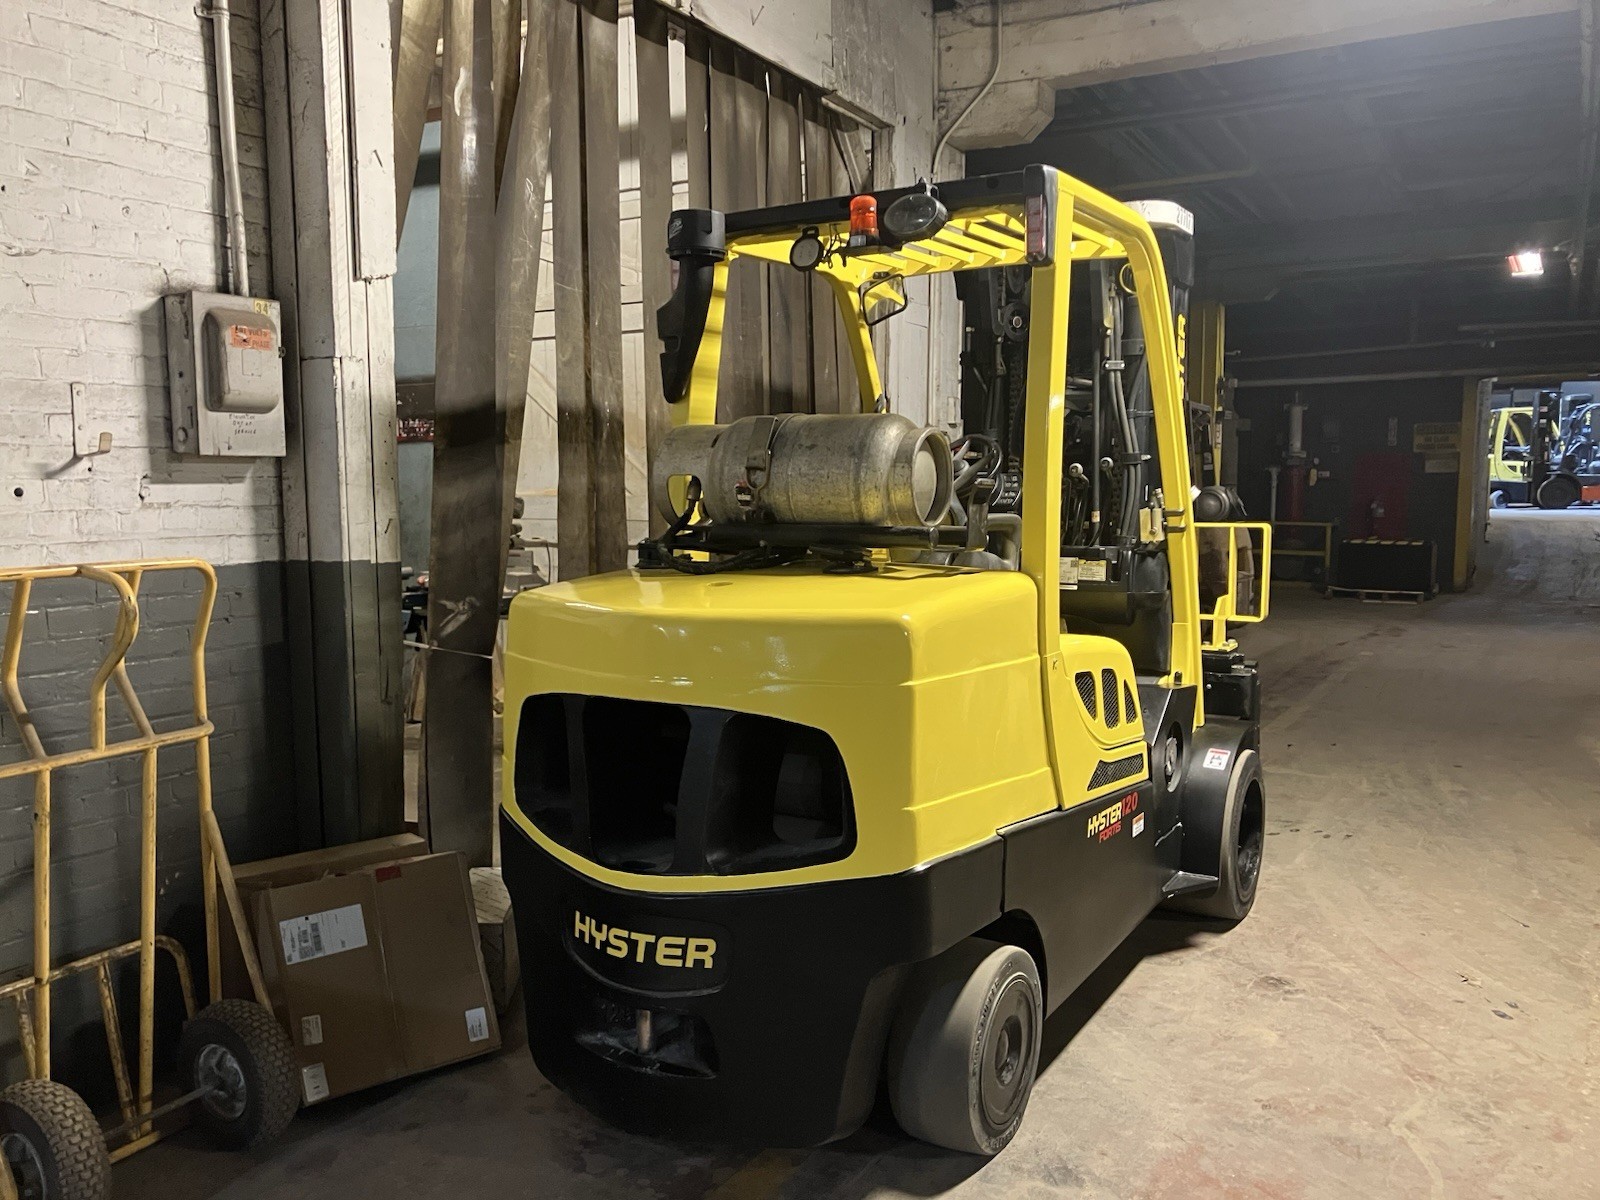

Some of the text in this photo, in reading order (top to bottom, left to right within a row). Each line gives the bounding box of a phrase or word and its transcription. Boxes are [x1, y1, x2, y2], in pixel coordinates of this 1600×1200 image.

[256, 302, 269, 315] 34
[1087, 801, 1122, 839] HYSTER
[1121, 791, 1139, 818] 120
[1099, 820, 1122, 844] FORTIS
[574, 910, 717, 969] HYSTER
